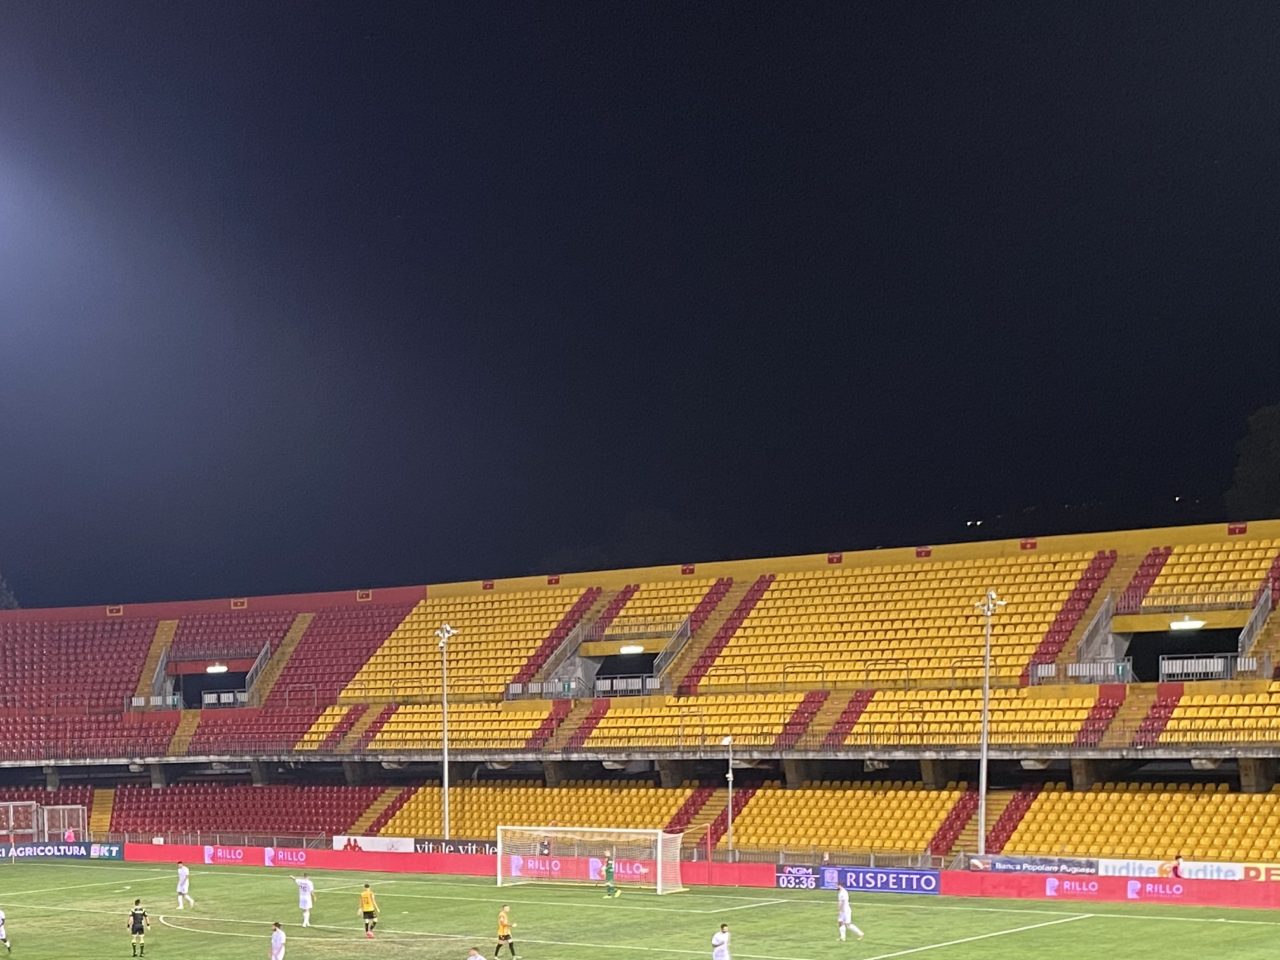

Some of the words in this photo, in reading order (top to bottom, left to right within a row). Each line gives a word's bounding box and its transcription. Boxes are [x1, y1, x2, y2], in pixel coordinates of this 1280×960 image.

[8, 845, 87, 858] AGRICOLTURA
[90, 844, 119, 857] BKT
[217, 849, 244, 859] RILLO
[416, 841, 455, 854] vitale
[458, 843, 498, 856] vitale
[278, 850, 306, 861] RILLO
[527, 859, 560, 871] RILLO
[615, 862, 643, 874] ILLO
[779, 876, 816, 889] 03:36
[846, 872, 937, 891] RISPETTO
[1063, 881, 1099, 892] RILLO
[1145, 883, 1184, 895] RILLO
